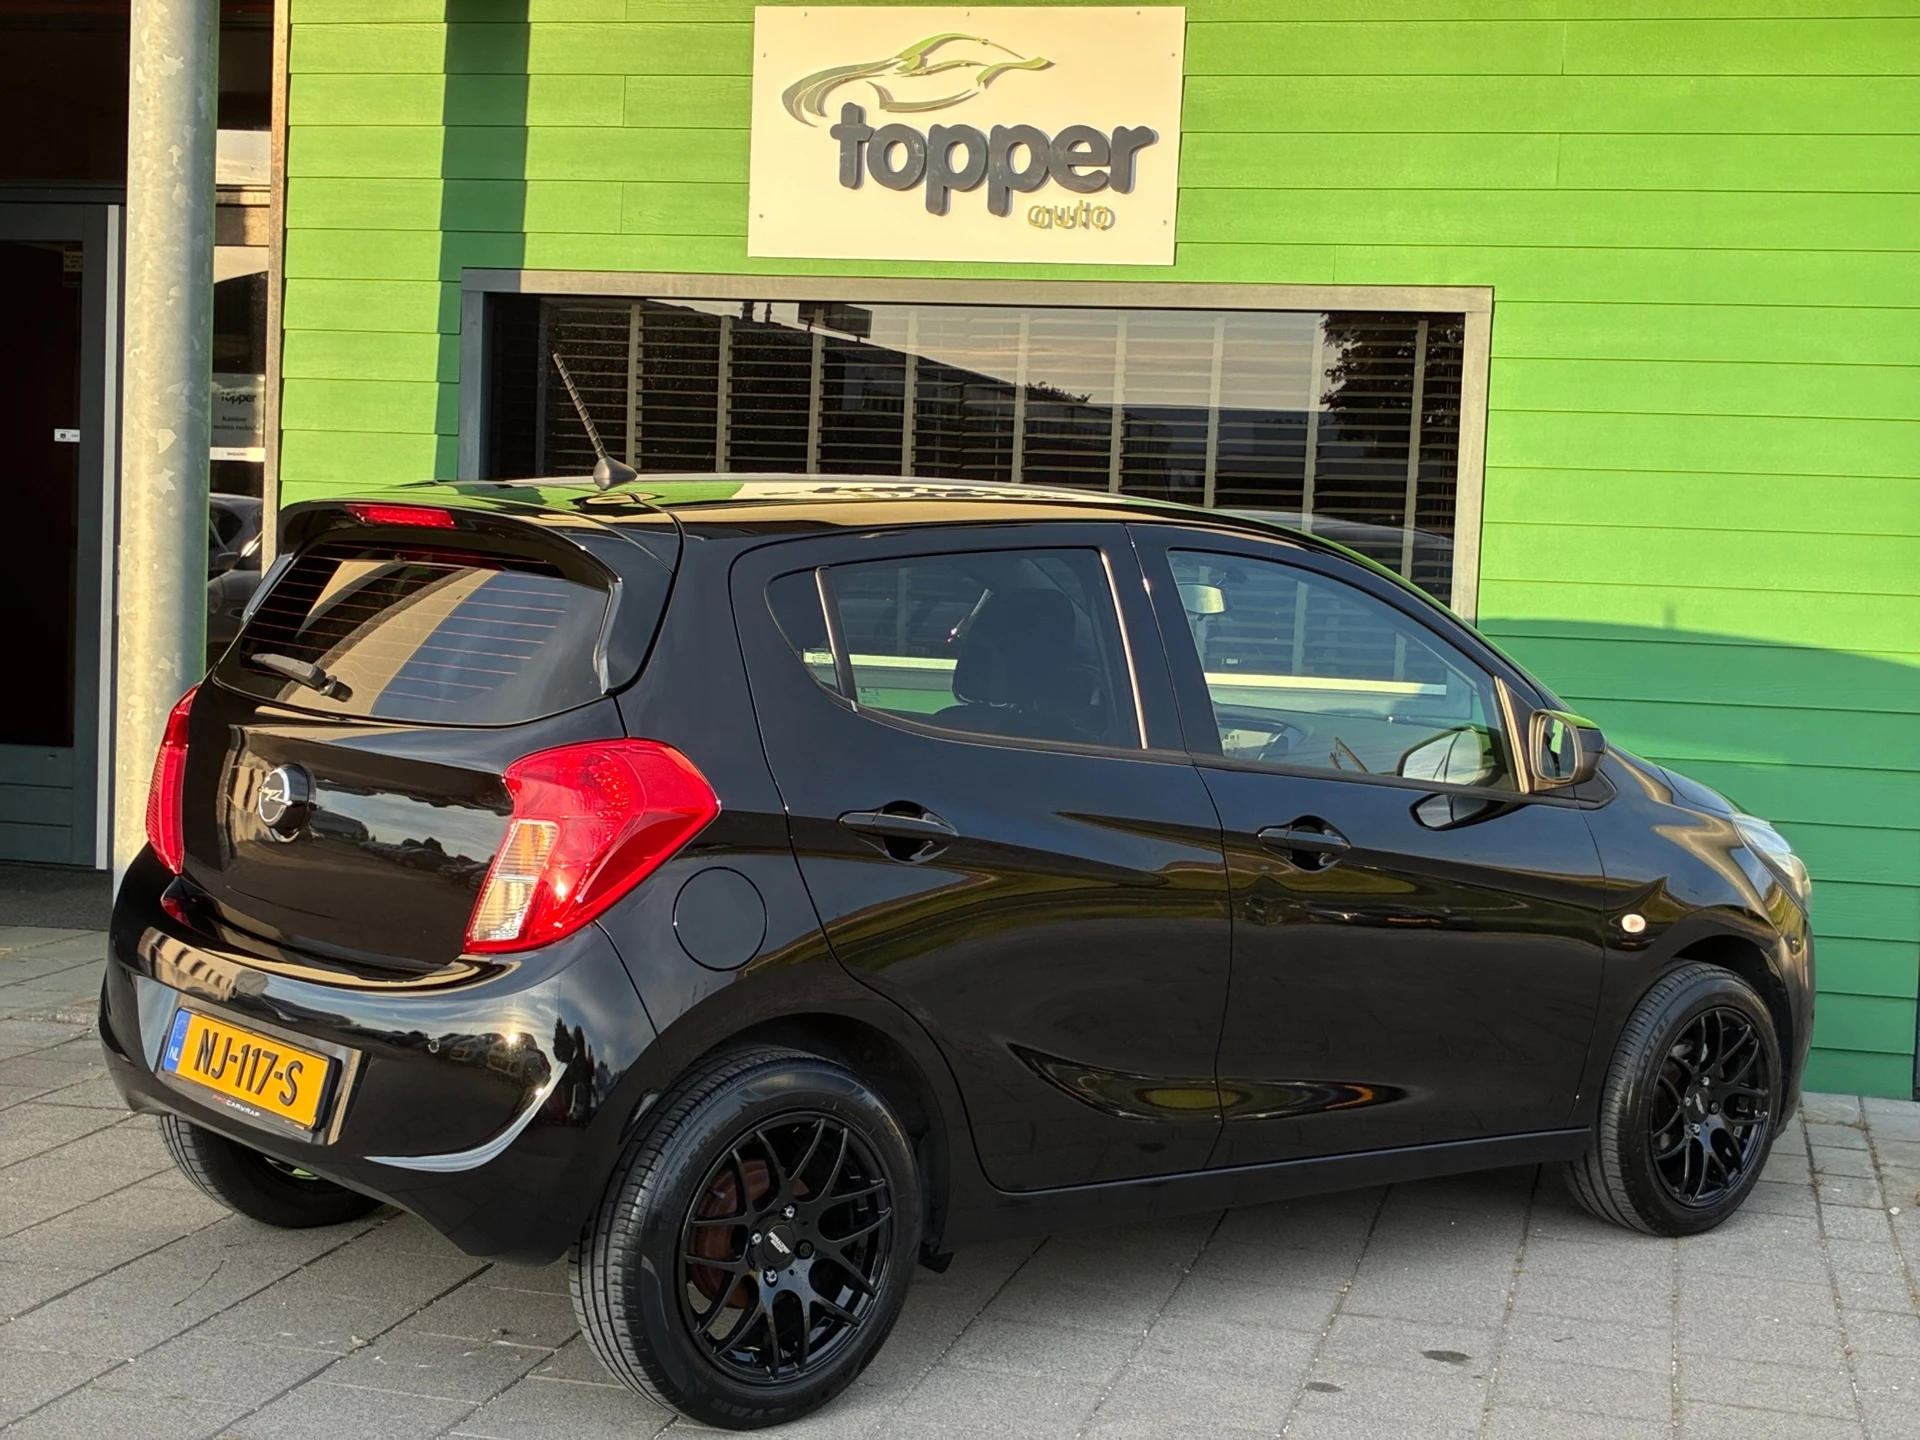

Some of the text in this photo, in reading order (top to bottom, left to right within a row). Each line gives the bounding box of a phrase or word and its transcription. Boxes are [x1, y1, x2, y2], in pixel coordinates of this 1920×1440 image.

[830, 102, 1158, 216] topper
[1027, 199, 1113, 230] auto
[168, 1045, 179, 1061] NL
[193, 1028, 304, 1107] NJ-117-S
